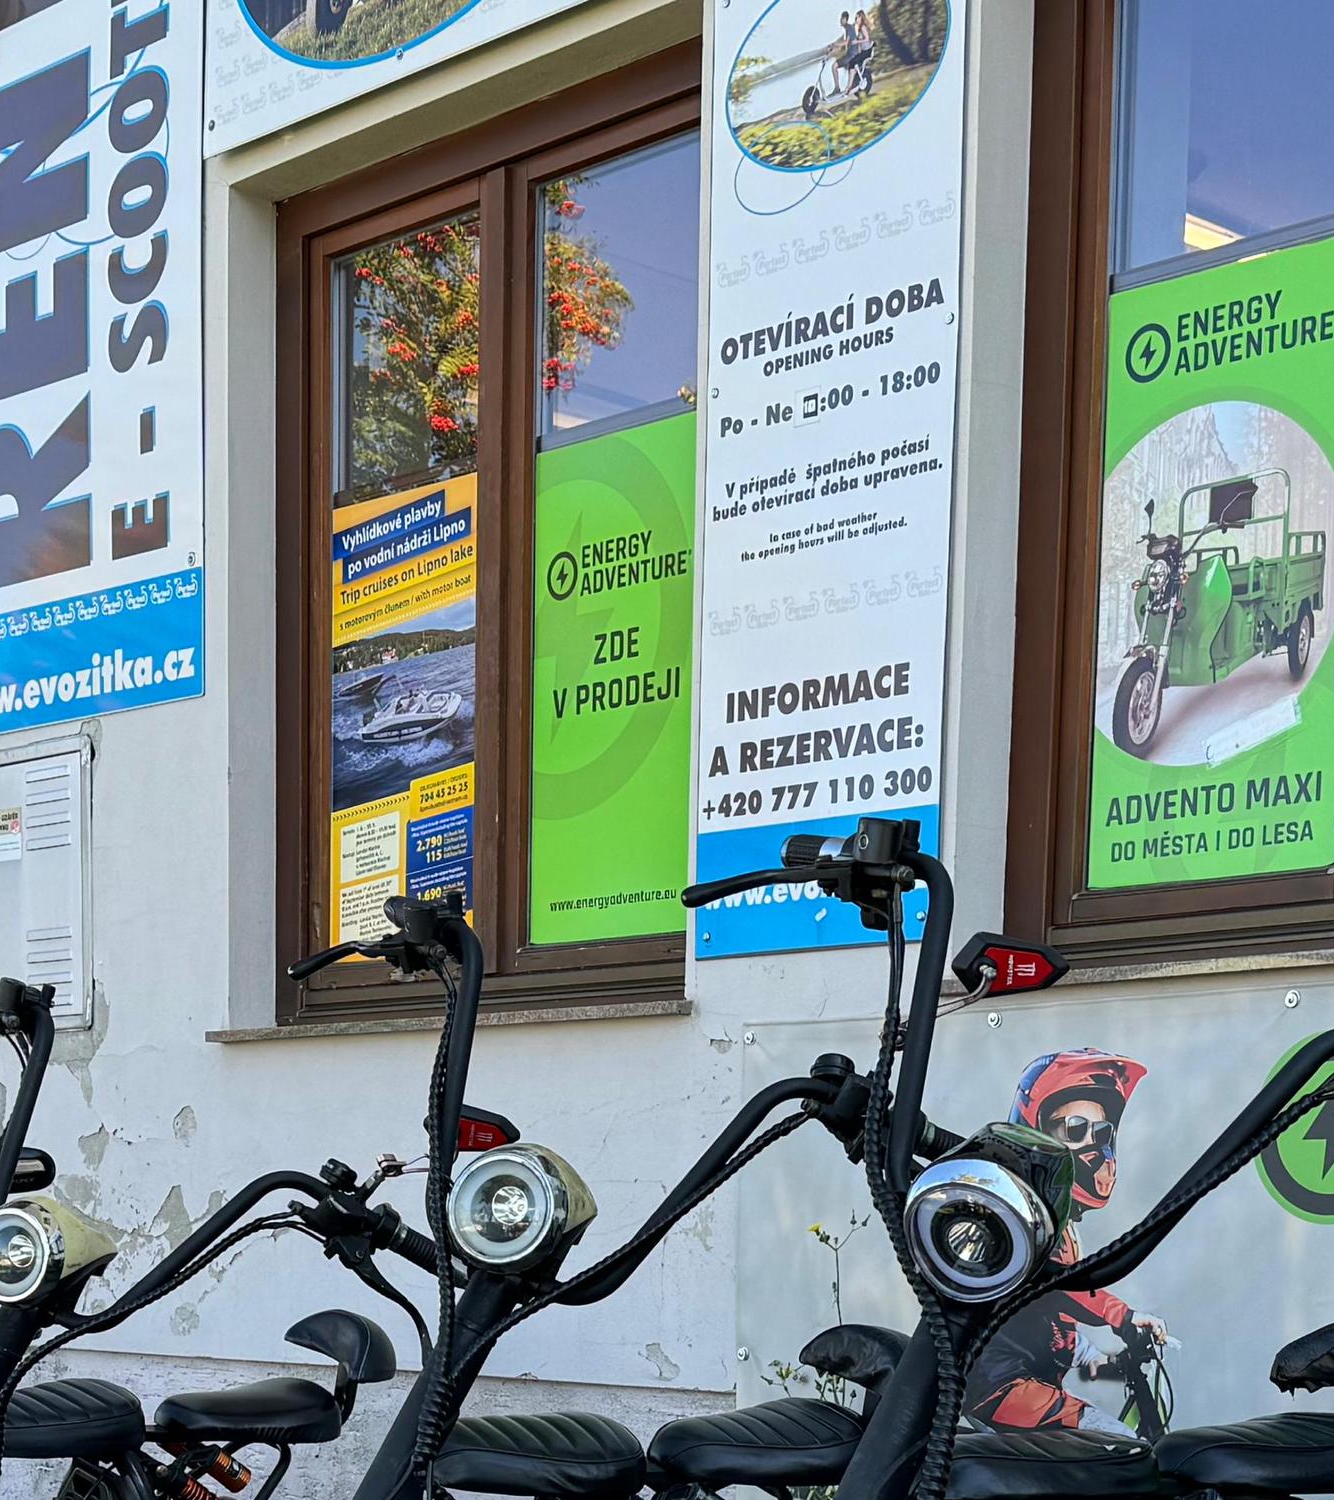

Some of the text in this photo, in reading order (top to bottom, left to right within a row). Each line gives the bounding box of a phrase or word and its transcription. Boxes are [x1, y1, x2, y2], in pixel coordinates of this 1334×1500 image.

[720, 278, 945, 365] OTEVÍRACÍ DOBA
[1176, 289, 1283, 343] ENERGY
[763, 326, 894, 377] OPENING HOURS
[720, 362, 941, 438] Po Ne 18:00
[712, 460, 944, 522] bude otevírací doba upravena.
[725, 434, 931, 500] V případě špatného počasí
[111, 490, 169, 561] E
[342, 500, 442, 552] Vyhlídkové plavby
[348, 519, 466, 579] po vodní nádrži Lipno
[581, 530, 653, 569] ENERGY
[741, 517, 909, 563] the opening hours will be adjusted.
[770, 511, 878, 543] In case of bad weather
[340, 544, 474, 605] Trip cruises on Lipno lake
[415, 588, 431, 603] with
[593, 626, 640, 665] ZDE
[552, 667, 681, 720] V PRODEJI
[726, 662, 911, 723] INFORMACE
[708, 716, 925, 778] A REZERVACE:
[435, 781, 469, 801] 45 25 25
[702, 766, 933, 820] +420 777 110 300
[1105, 770, 1323, 827] ADVENTO MAXI
[416, 835, 442, 852] 2.790
[425, 849, 442, 864] 115
[1111, 820, 1314, 863] DO MĚSTA DO LESA
[549, 888, 678, 913] www.energyadventure.eu
